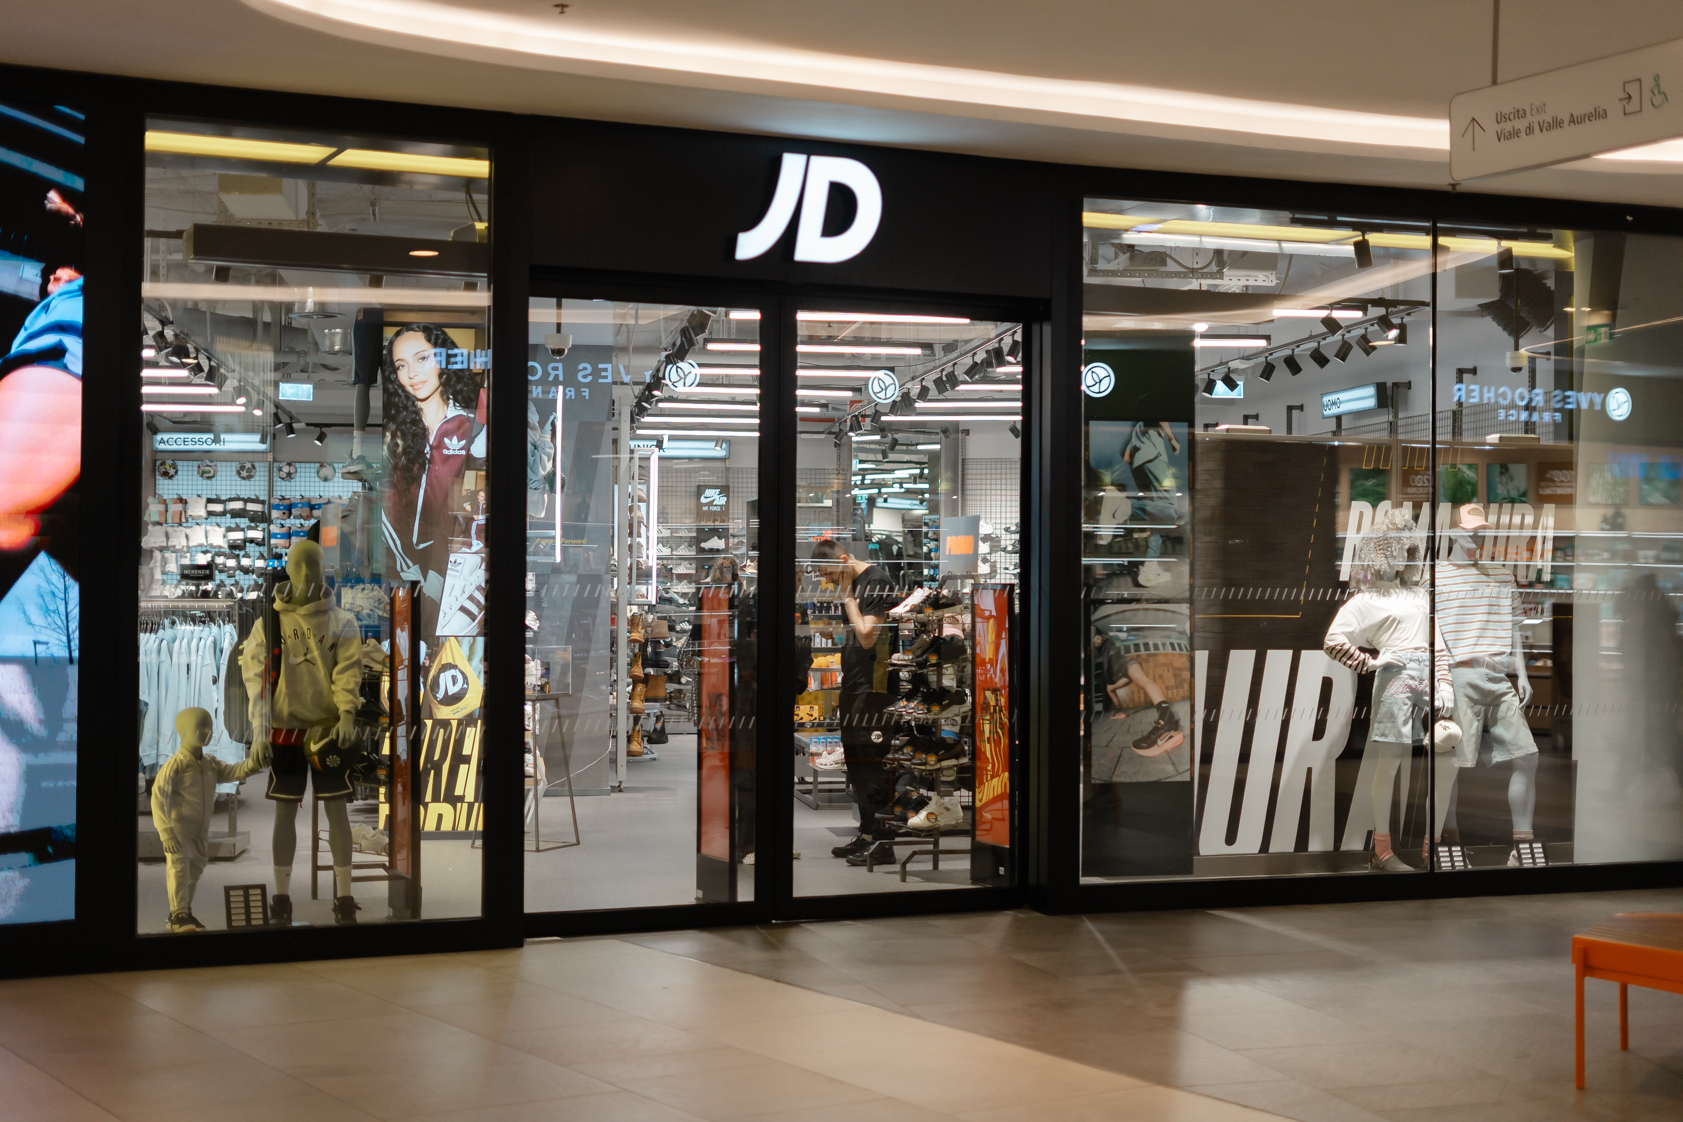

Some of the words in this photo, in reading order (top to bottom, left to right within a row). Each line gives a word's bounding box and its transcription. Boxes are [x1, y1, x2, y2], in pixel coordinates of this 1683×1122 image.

[1495, 107, 1527, 125] Uscita
[1530, 101, 1547, 117] Exit
[1495, 125, 1522, 142] Viale
[1525, 121, 1535, 137] di
[1537, 115, 1565, 134] Valle
[1568, 106, 1608, 127] Aurelia
[735, 152, 883, 264] JD
[1323, 397, 1341, 411] UOMO
[158, 437, 226, 446] ACCESSOI
[704, 488, 721, 497] NIKE
[713, 497, 727, 505] AIR
[280, 627, 336, 653] ORDAN
[436, 668, 464, 701] JD
